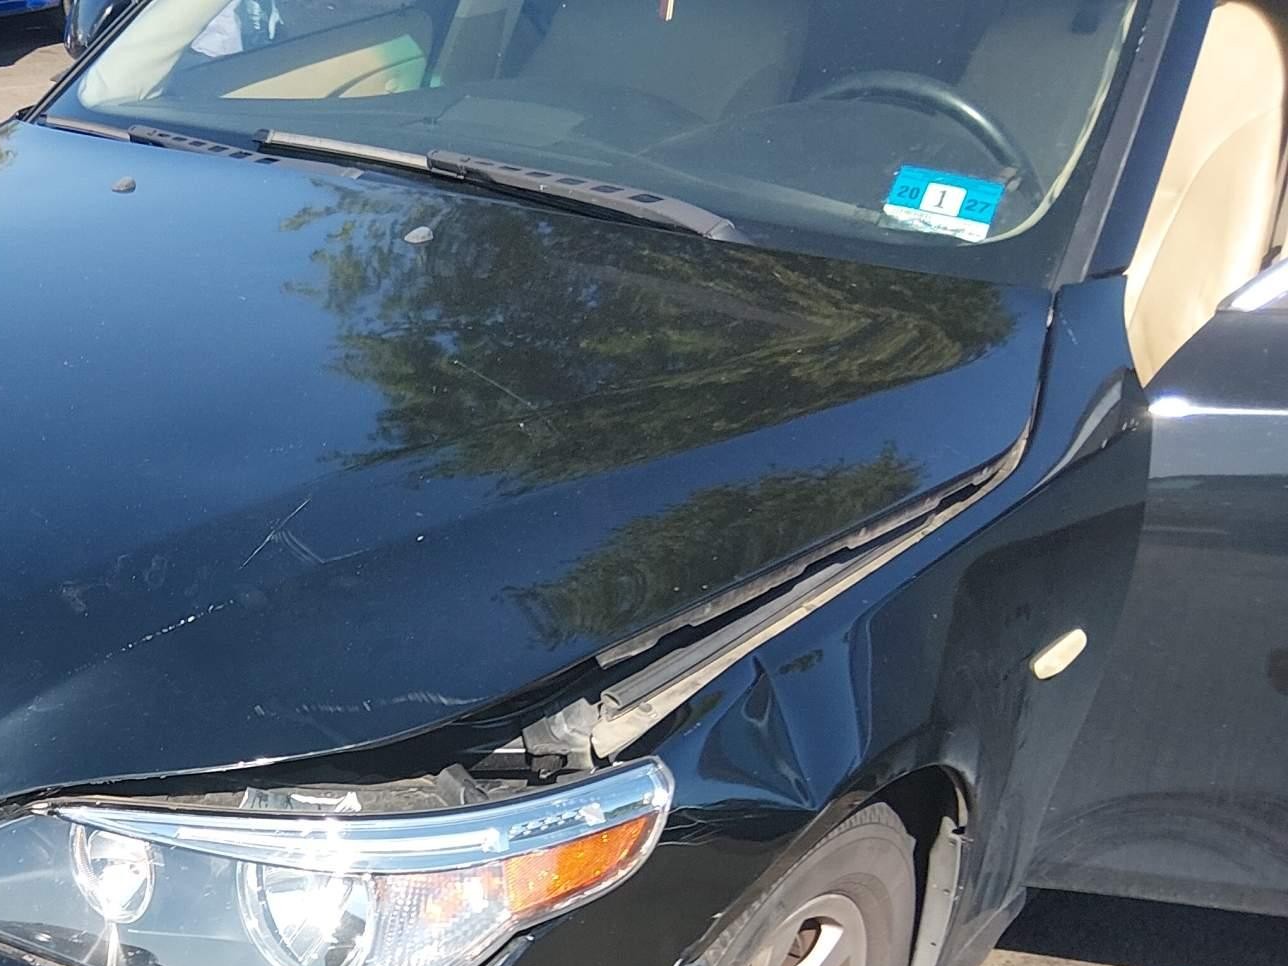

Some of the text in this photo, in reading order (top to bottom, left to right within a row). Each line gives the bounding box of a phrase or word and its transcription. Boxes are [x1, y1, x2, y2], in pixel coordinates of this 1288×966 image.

[897, 184, 991, 214] 20 1 27
